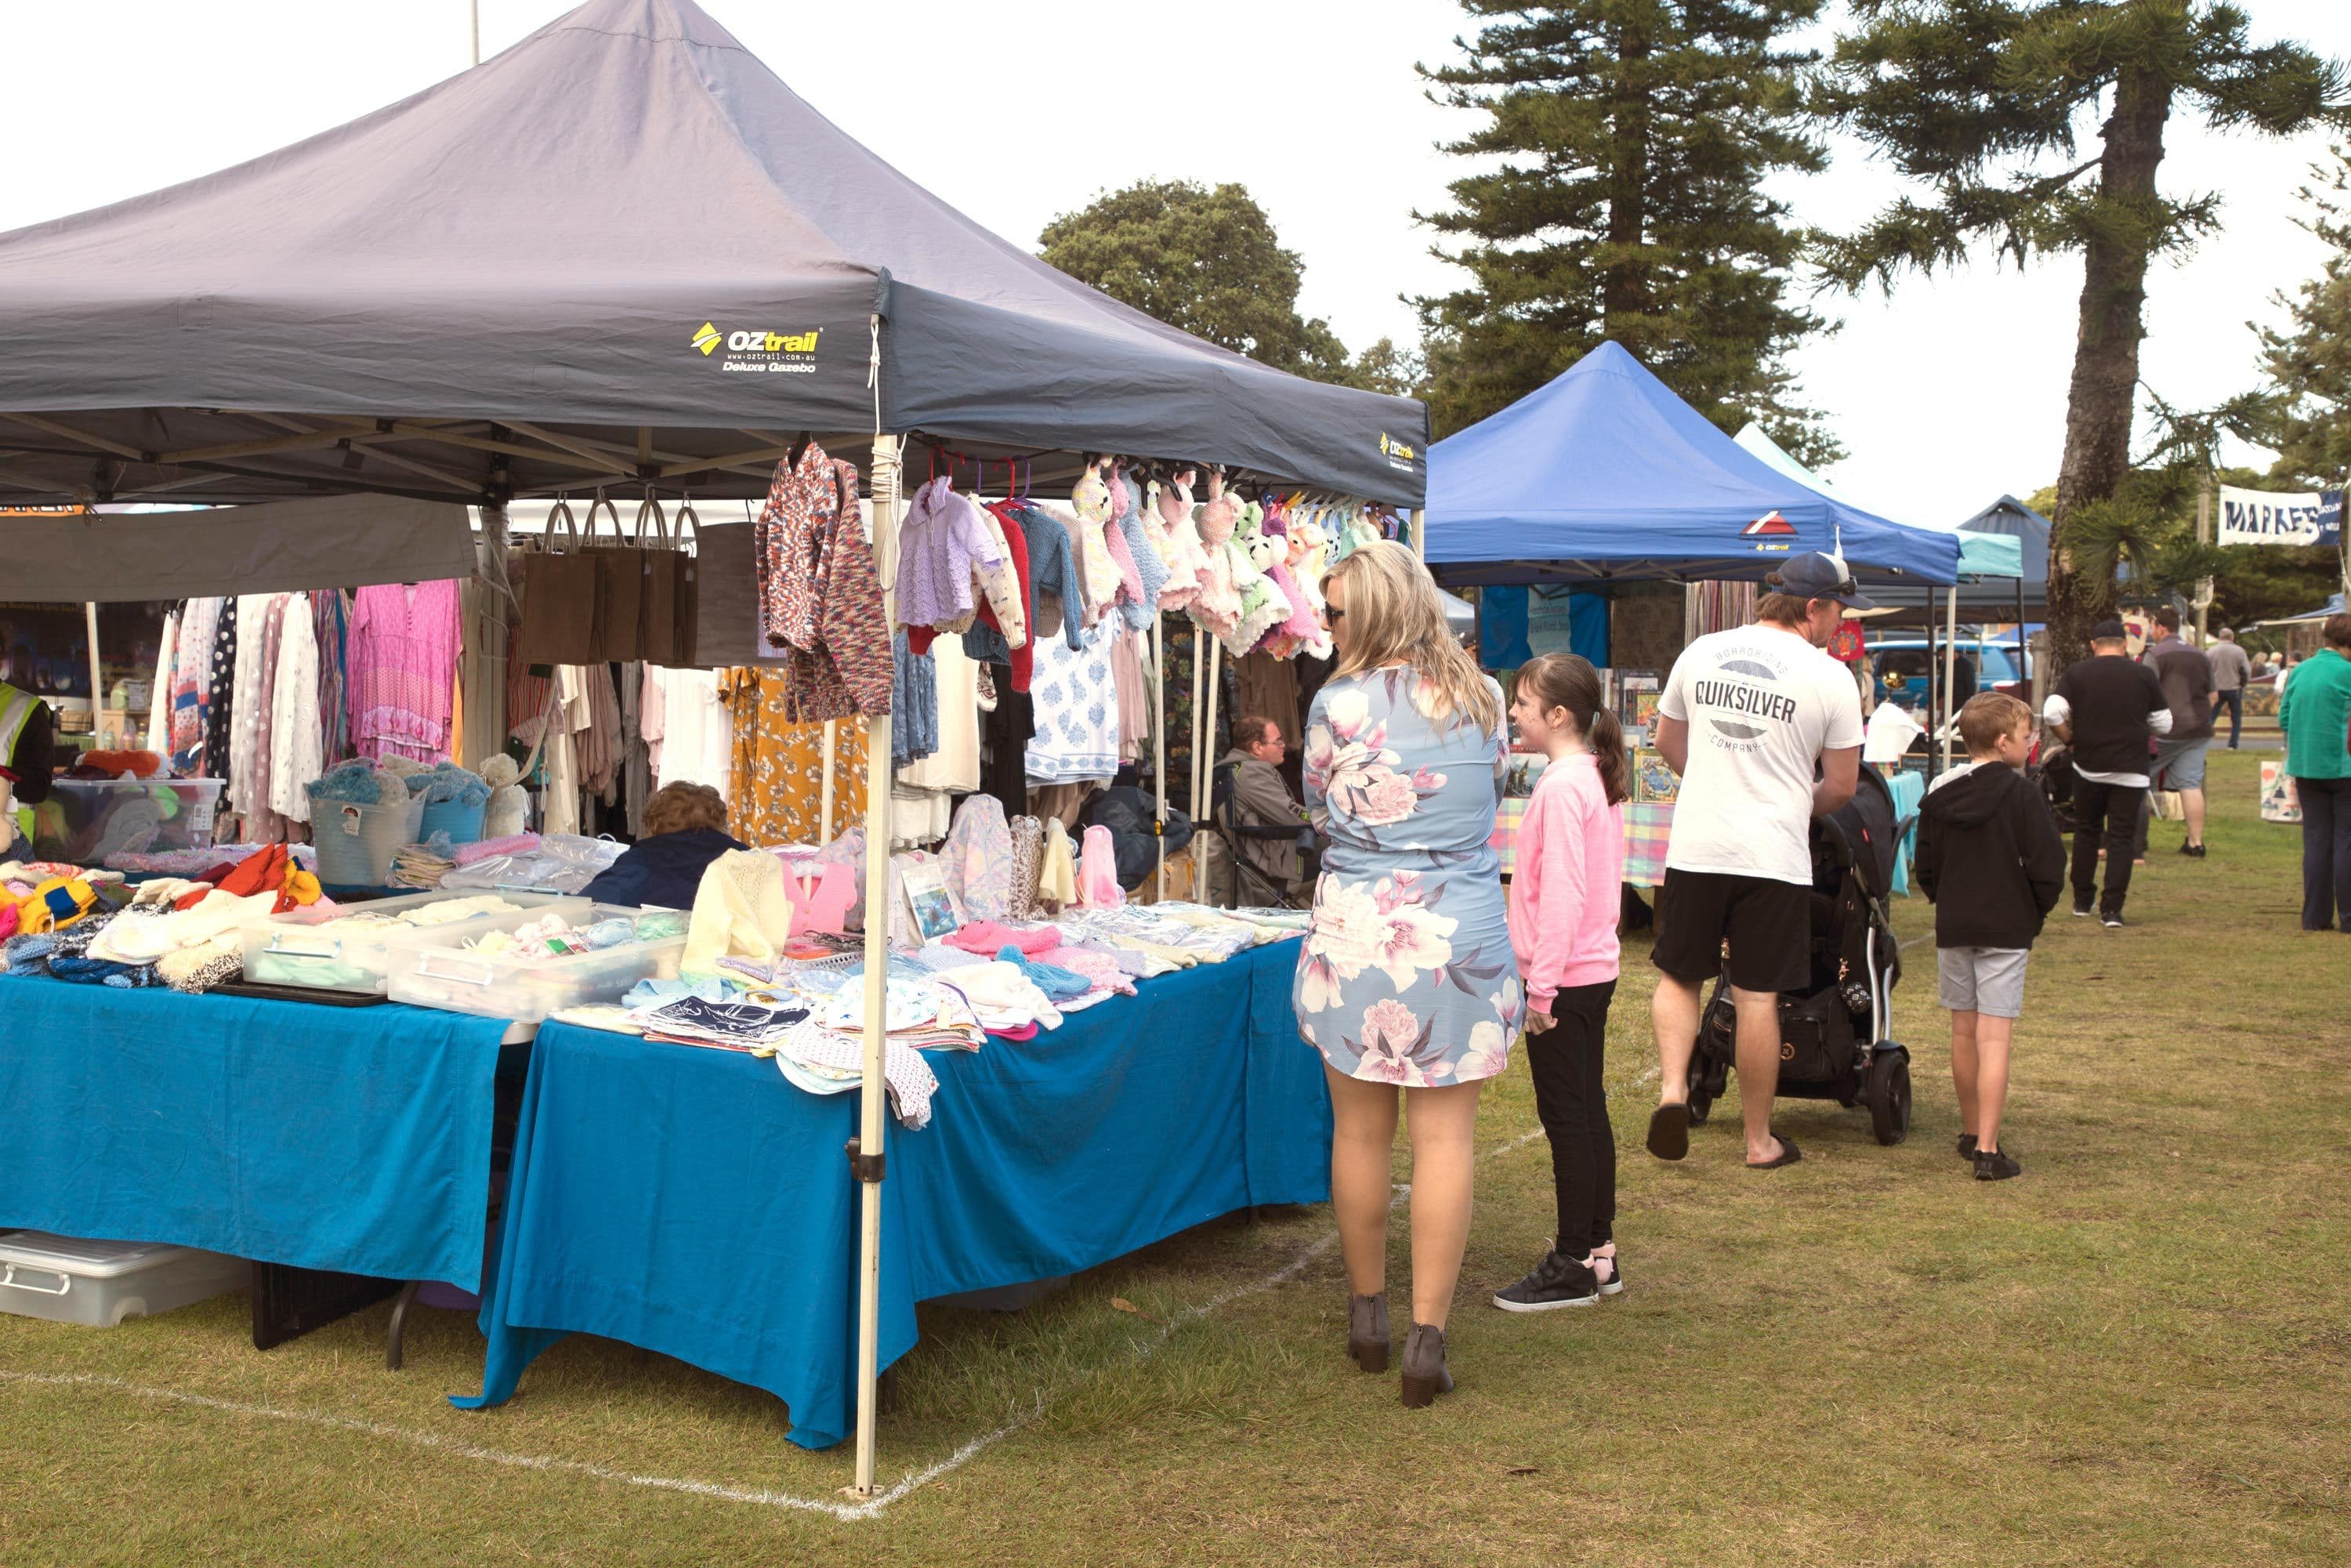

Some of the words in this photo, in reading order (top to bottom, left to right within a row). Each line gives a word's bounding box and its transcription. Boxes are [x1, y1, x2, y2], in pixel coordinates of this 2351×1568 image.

[727, 331, 819, 352] OZtrail
[723, 361, 766, 372] Deluxe
[768, 362, 816, 373] Gazebo
[1715, 646, 1788, 675] BOARDRDING
[1696, 680, 1796, 723] QUIKSILVER
[1709, 734, 1759, 753] COMPANY
